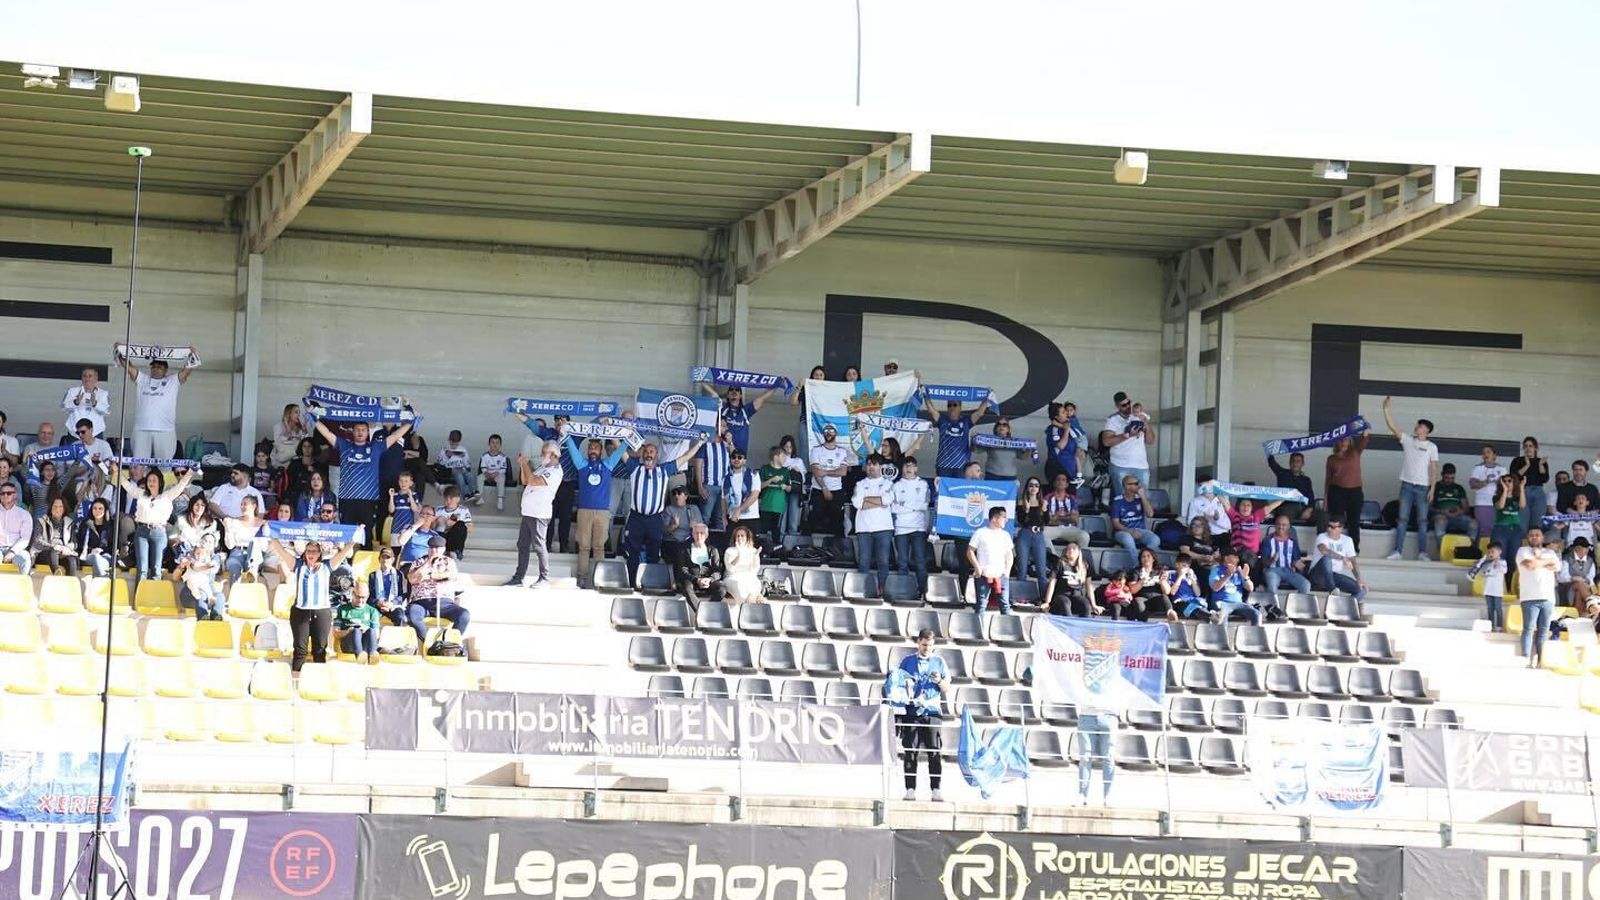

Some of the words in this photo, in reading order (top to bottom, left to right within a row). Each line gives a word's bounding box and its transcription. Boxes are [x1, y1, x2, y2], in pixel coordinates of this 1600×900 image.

[130, 346, 175, 359] XEREZ
[716, 370, 759, 385] XEREZ
[760, 375, 778, 386] CD
[312, 387, 353, 404] XEREZ
[569, 422, 623, 437] XEREZ
[867, 414, 920, 430] XEREZ
[1291, 432, 1330, 449] XEREZ
[1332, 424, 1348, 438] CD
[1046, 648, 1082, 663] Nueva
[455, 702, 650, 737] Inmobiliaria
[654, 704, 846, 747] TENORIO
[37, 794, 116, 816] XEREZ
[484, 832, 849, 900] Lepephone
[1031, 842, 1227, 879] ROTULACIONES
[1233, 853, 1359, 884] JECAR
[1069, 878, 1225, 895] ESPECIALISTAS
[1232, 882, 1260, 896] EN
[1263, 884, 1322, 898] ROPA
